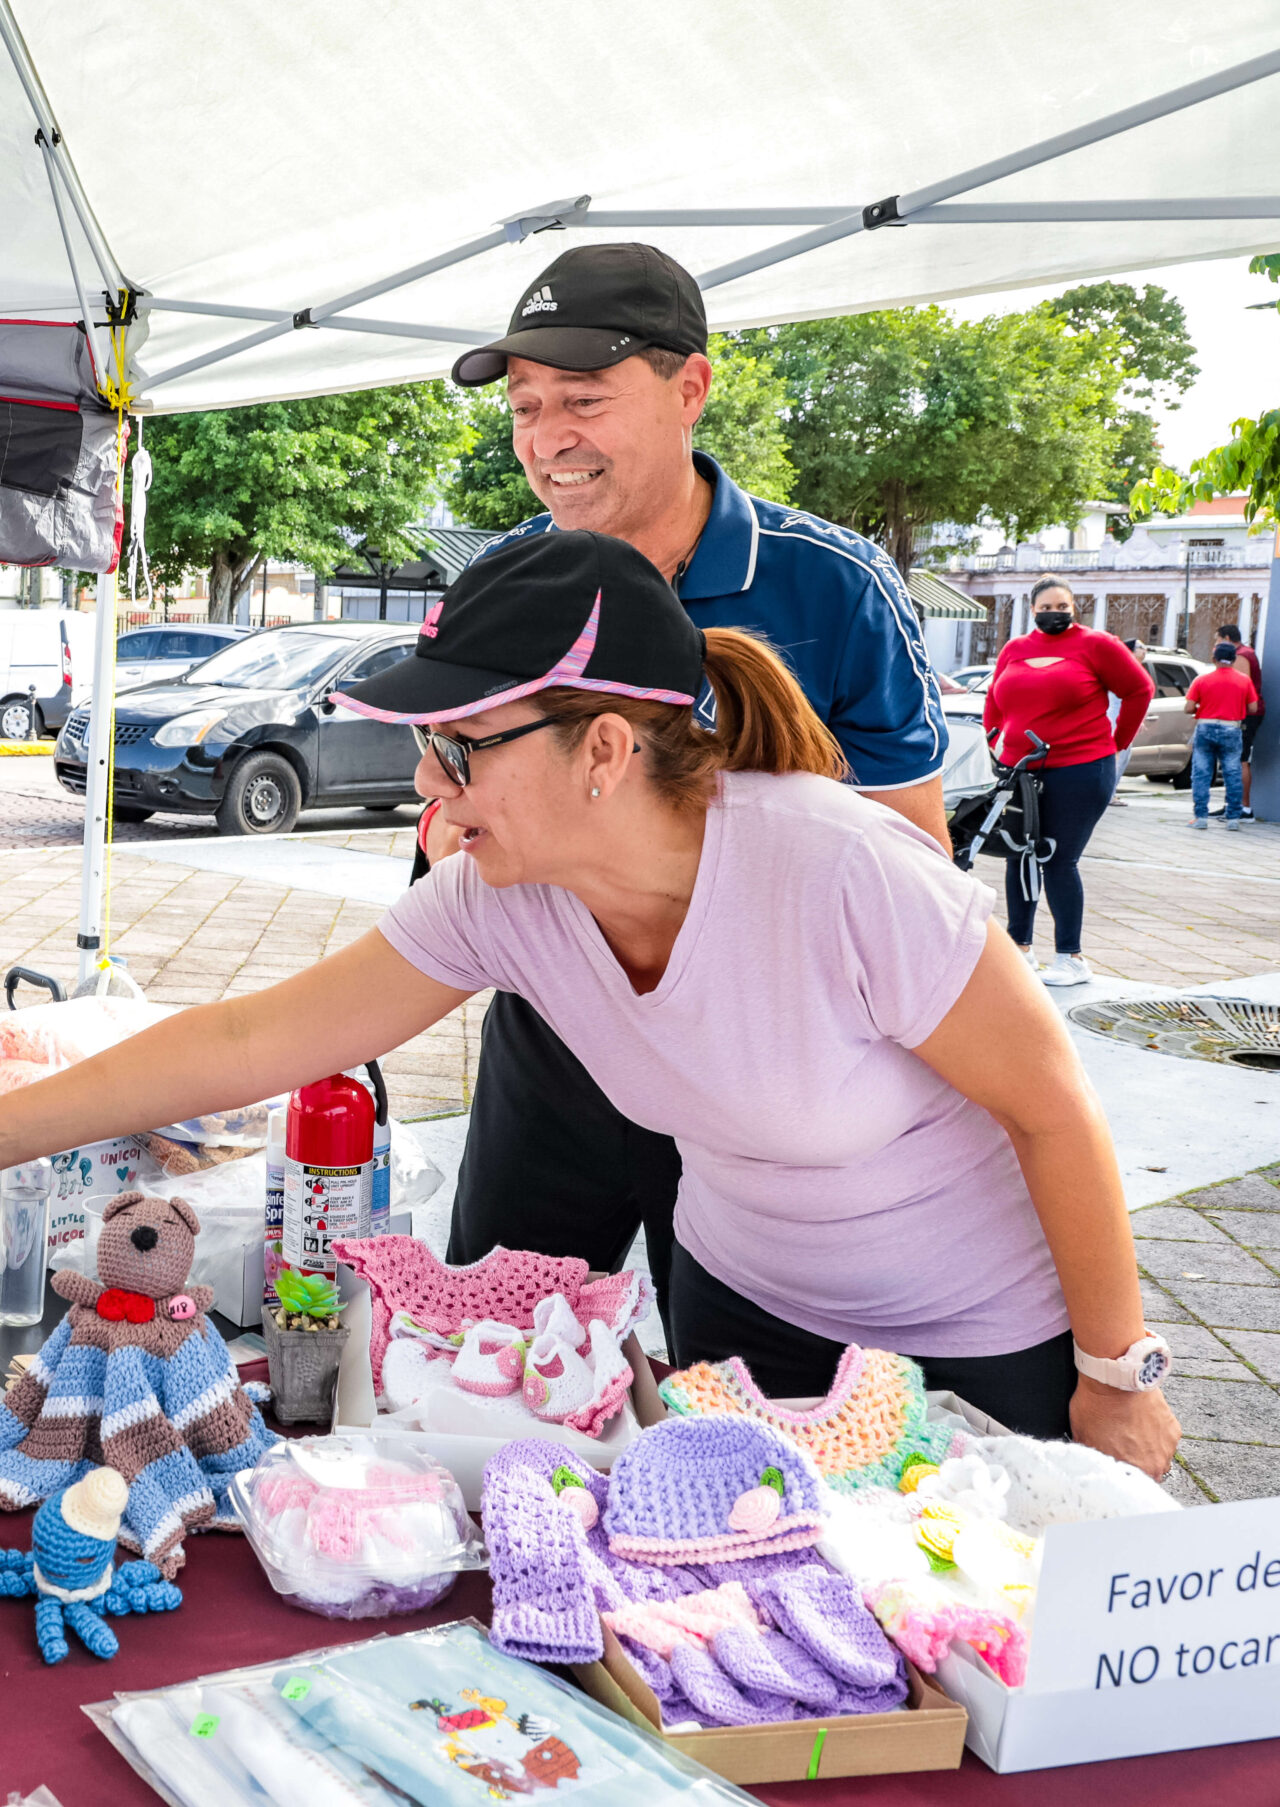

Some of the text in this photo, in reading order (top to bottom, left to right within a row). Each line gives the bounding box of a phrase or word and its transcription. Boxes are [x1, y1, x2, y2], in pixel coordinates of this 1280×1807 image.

[522, 299, 558, 317] adidas
[484, 679, 519, 697] adizero
[308, 1167, 358, 1176] INSTRUCTIONS
[1107, 1550, 1280, 1613] Favor de
[1095, 1633, 1280, 1690] NO tocar
